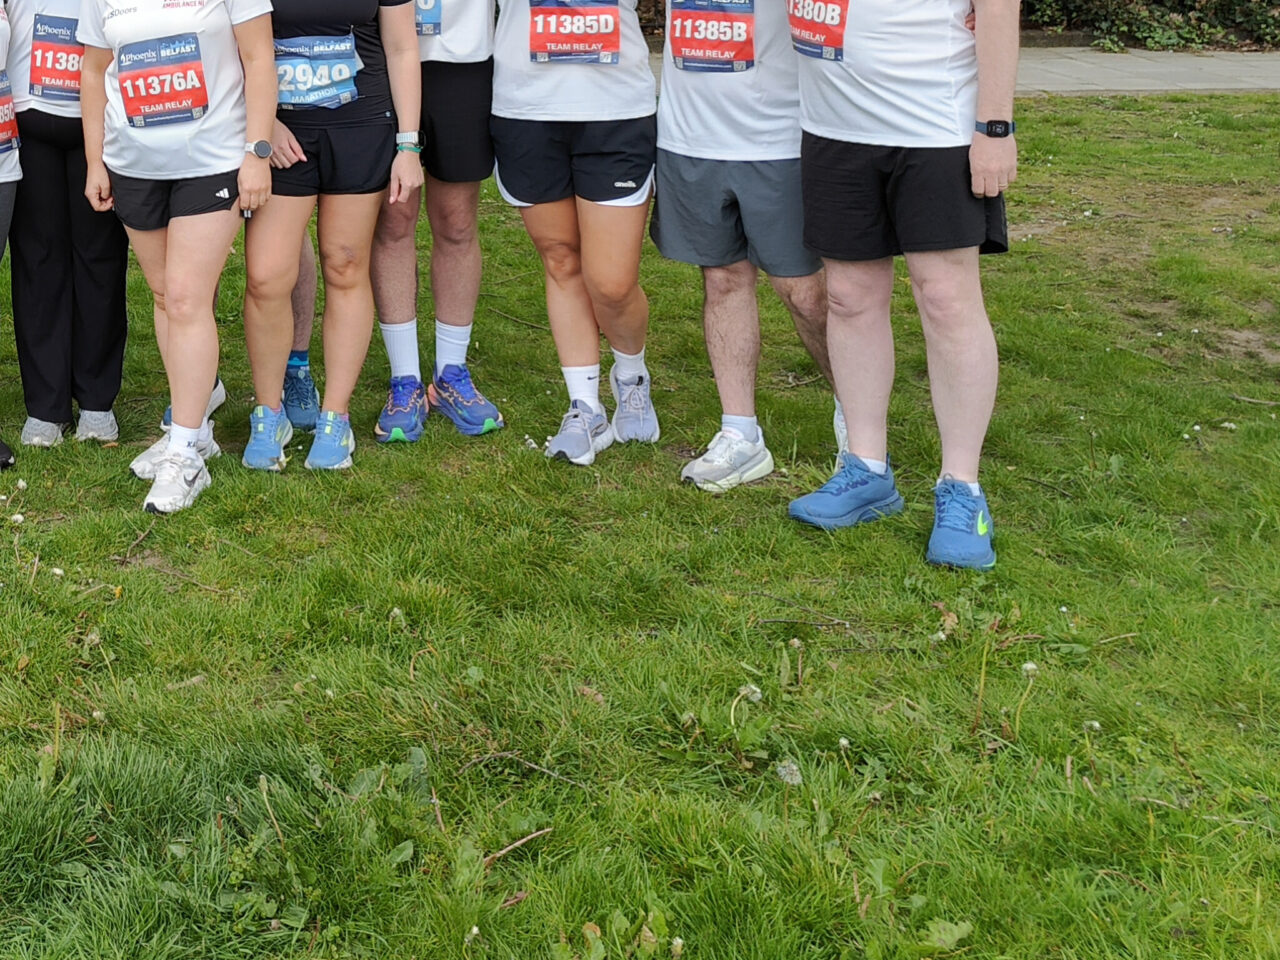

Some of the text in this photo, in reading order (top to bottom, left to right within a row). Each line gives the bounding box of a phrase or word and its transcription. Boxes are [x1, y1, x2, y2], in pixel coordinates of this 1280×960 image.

[42, 23, 71, 36] Phoenix
[534, 14, 614, 34] 11385D
[673, 18, 747, 42] 11385B
[126, 49, 157, 60] Phoenix
[160, 44, 197, 57] BELFAST
[314, 43, 352, 52] BELFAST
[546, 42, 604, 51] TEAM RELAY
[681, 48, 736, 59] TEAM RELAY
[41, 76, 80, 88] TEAM REL
[122, 70, 200, 98] 11376A
[291, 86, 338, 104] MARATHON
[140, 100, 192, 113] TEAM RELAY
